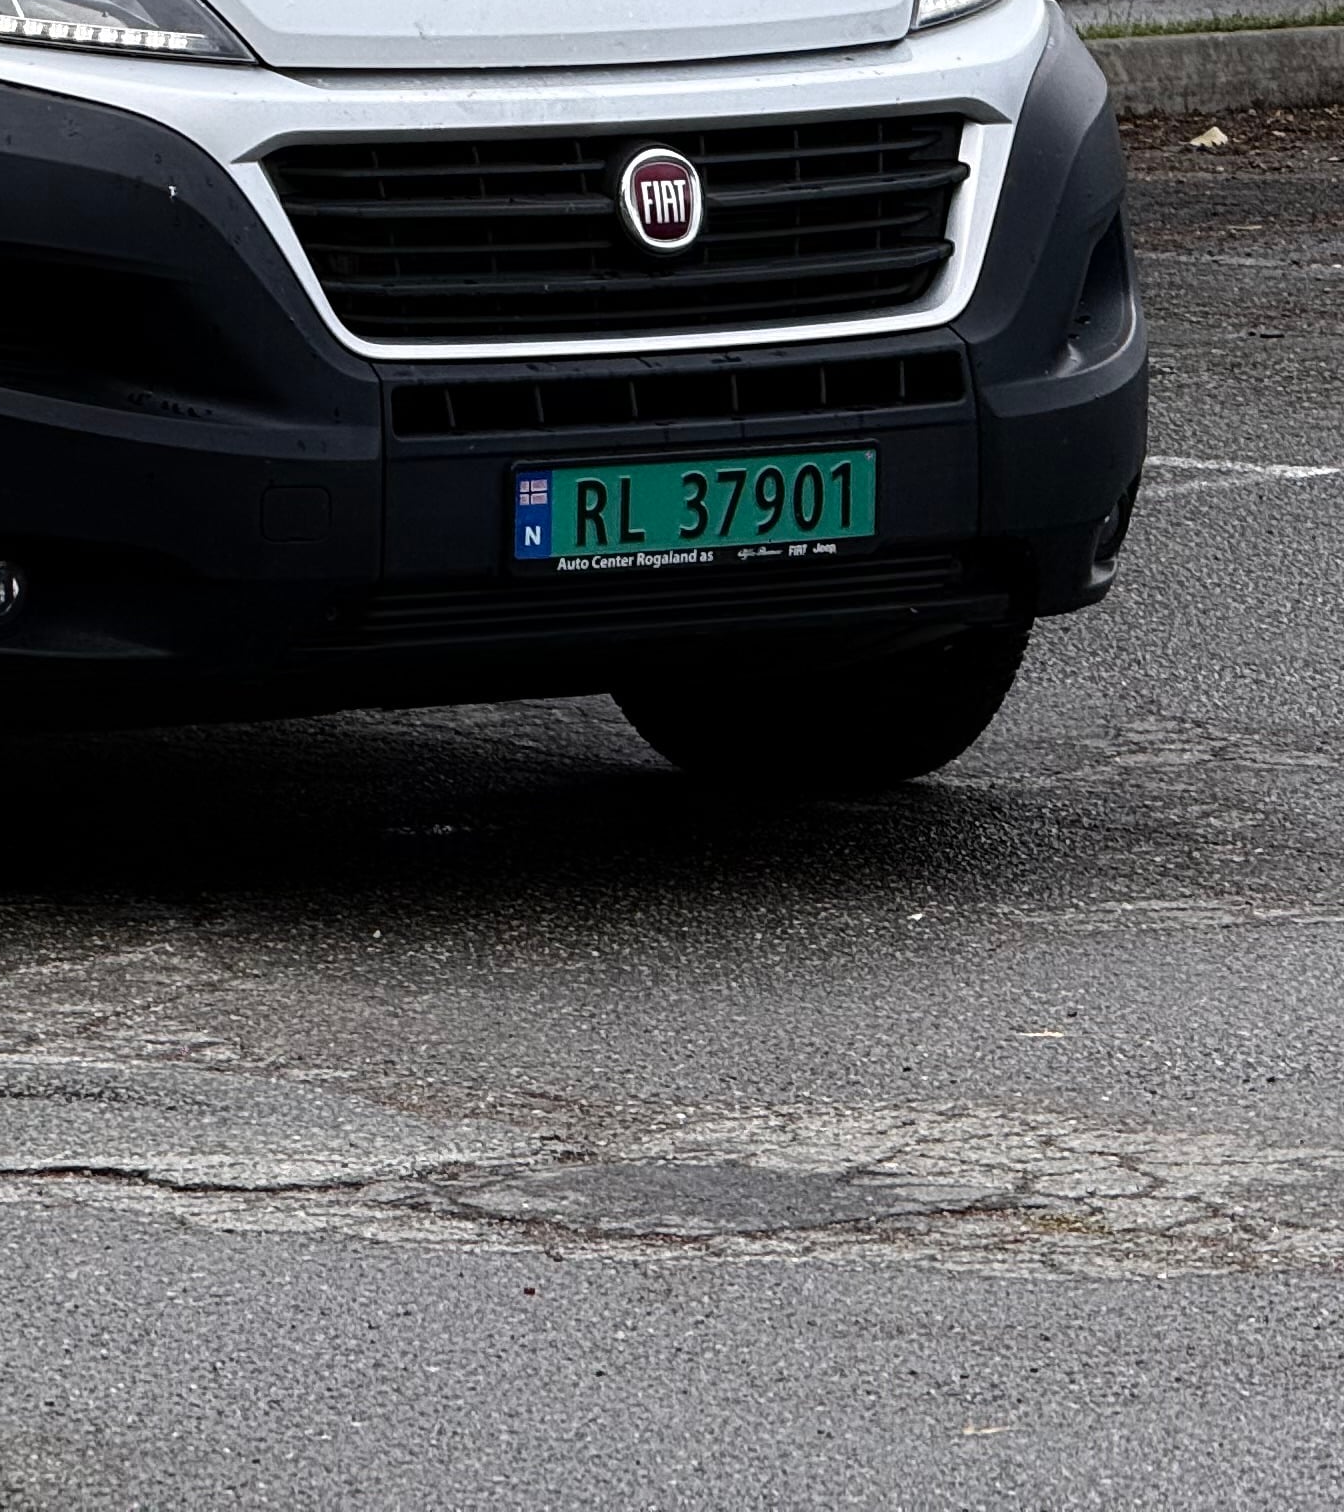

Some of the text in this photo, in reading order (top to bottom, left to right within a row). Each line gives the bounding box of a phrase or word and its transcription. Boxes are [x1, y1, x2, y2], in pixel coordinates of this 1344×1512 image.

[641, 179, 687, 225] FIAT
[575, 461, 853, 548] RL 37901
[524, 526, 542, 547] N
[557, 549, 714, 571] Auto Center Rogaland as
